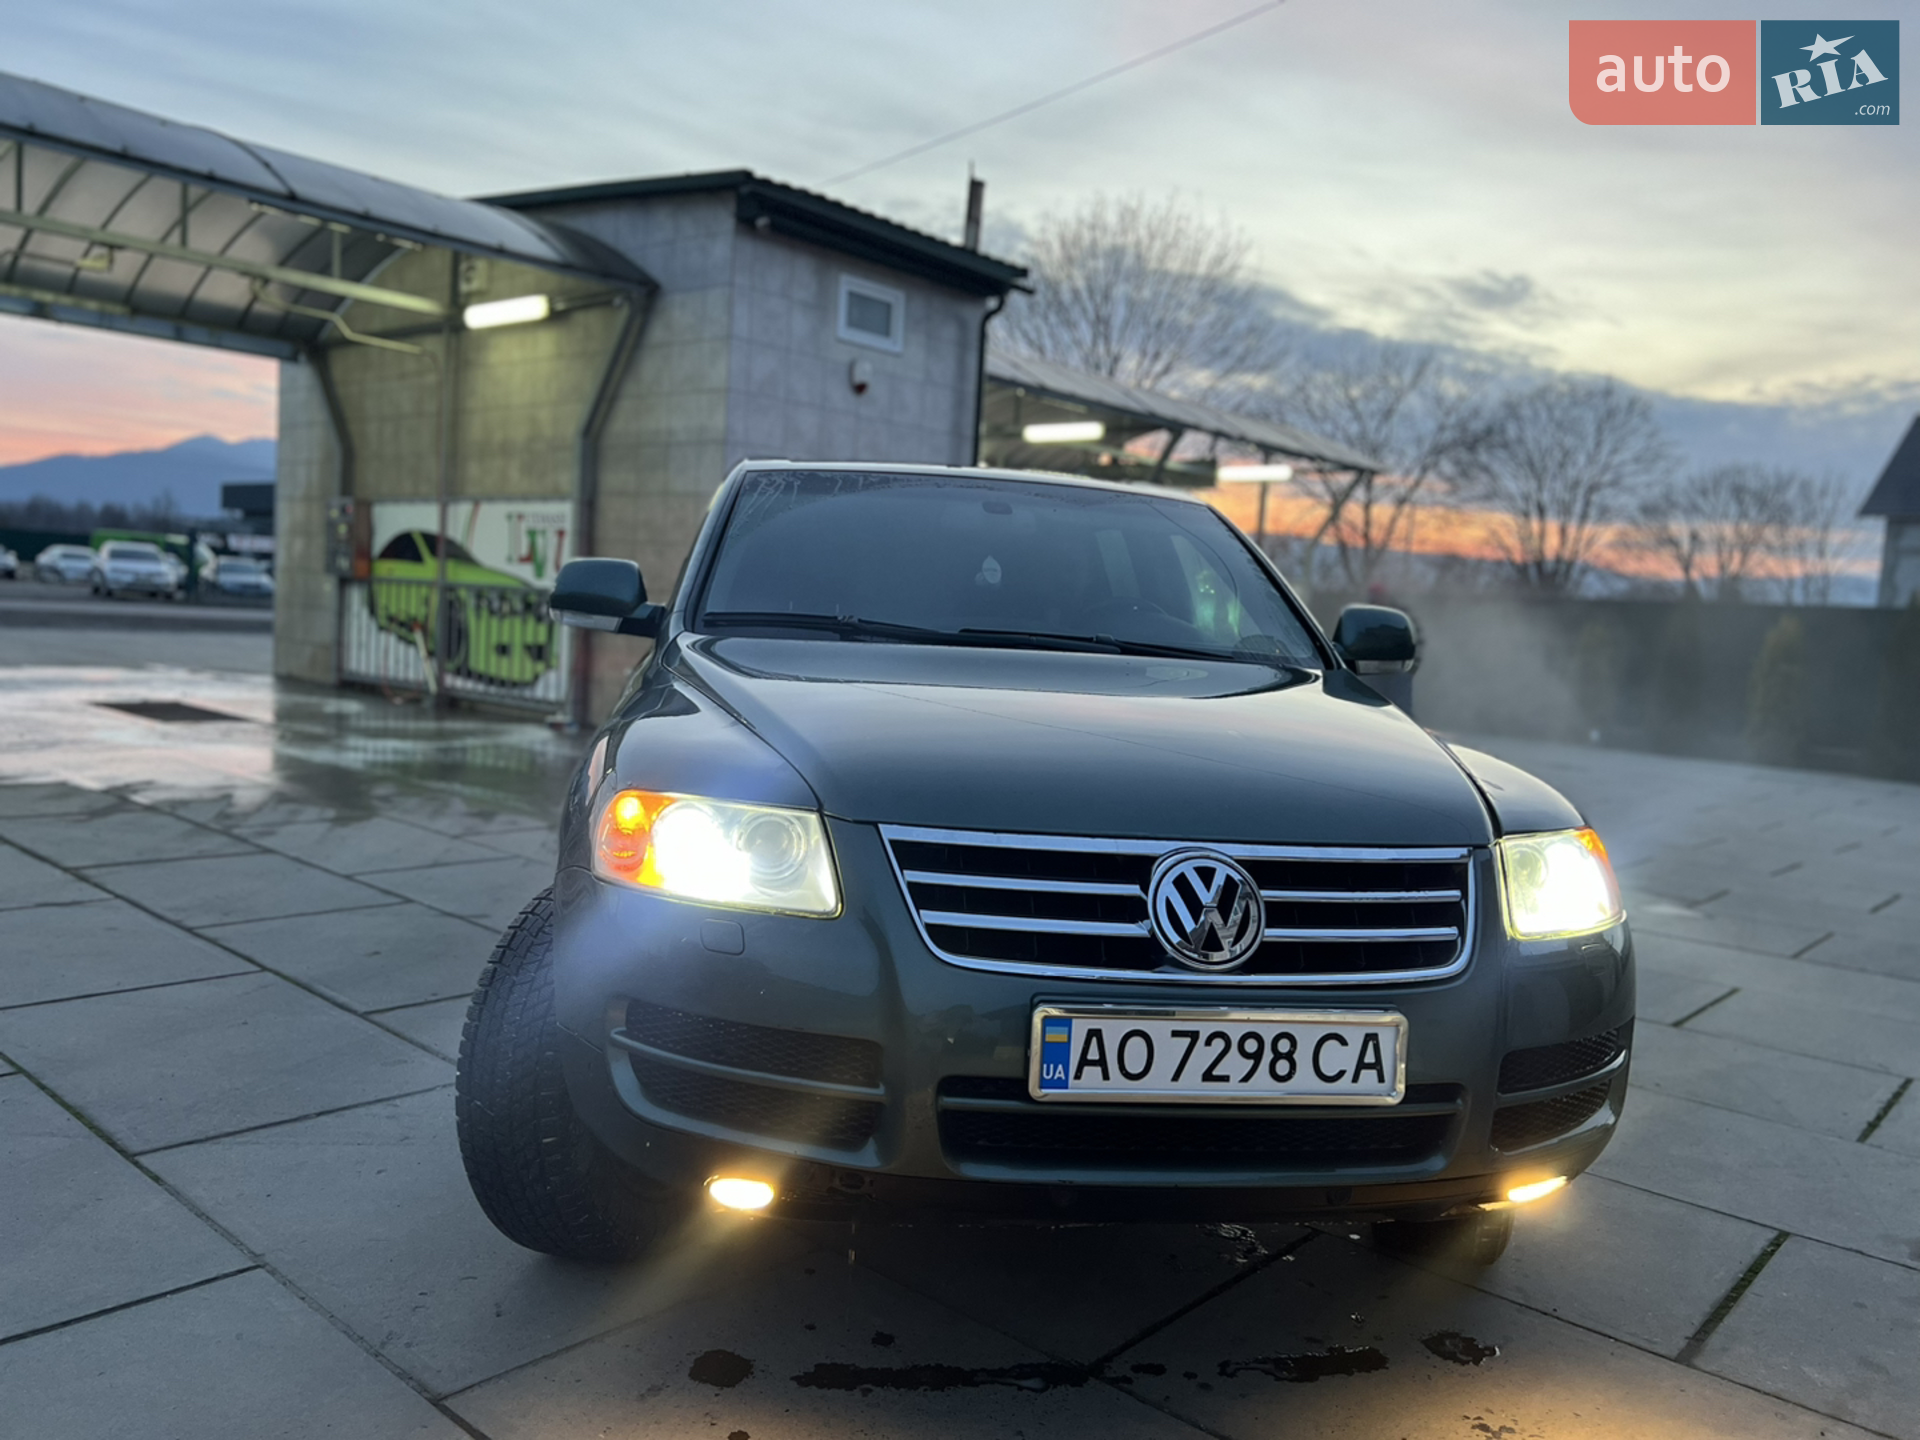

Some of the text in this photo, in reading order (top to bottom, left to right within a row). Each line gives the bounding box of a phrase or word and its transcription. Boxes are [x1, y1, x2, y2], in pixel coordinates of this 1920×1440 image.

[1043, 1064, 1067, 1081] UA
[1073, 1028, 1386, 1084] AO 7298 CA
